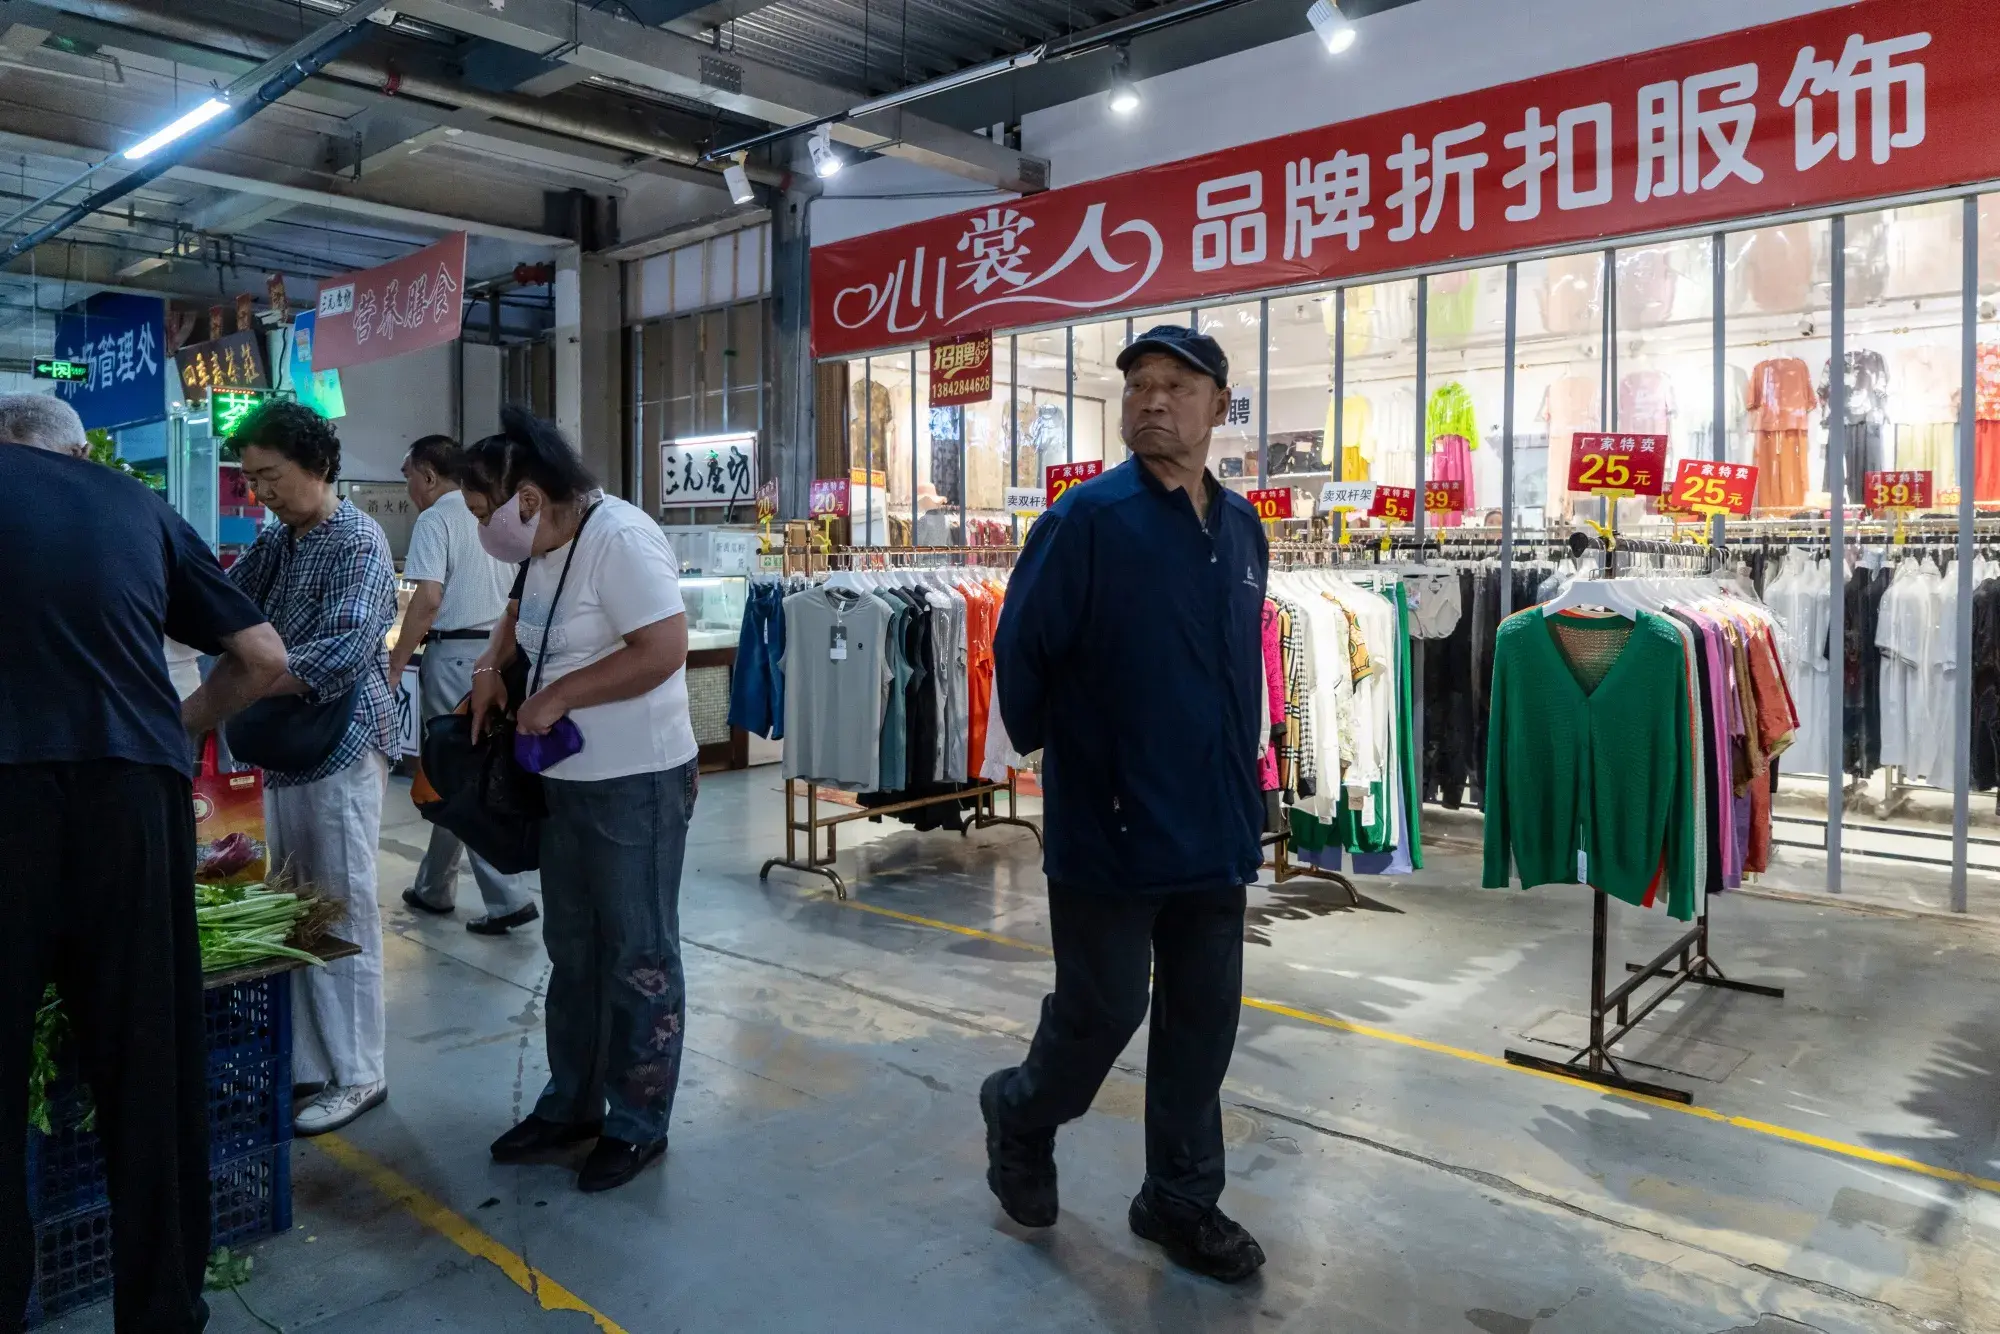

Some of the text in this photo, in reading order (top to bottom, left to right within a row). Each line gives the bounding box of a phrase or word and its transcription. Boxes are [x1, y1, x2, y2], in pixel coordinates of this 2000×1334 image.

[1193, 31, 1932, 272] 品牌折扣服饰
[353, 262, 457, 345] 营养膳食
[934, 341, 975, 370] 招聘
[932, 375, 990, 399] 13842844628
[1223, 396, 1251, 425] 聘
[1580, 436, 1655, 453] 厂家特卖
[1051, 463, 1096, 479] 厂家特卖
[1578, 453, 1651, 486] 25元
[1684, 462, 1749, 480] 厂家特卖
[815, 481, 846, 492] 厂家特卖
[1250, 489, 1286, 500] 厂家特卖
[1323, 488, 1372, 502] 卖双杆架
[1681, 476, 1744, 506] 25元
[1872, 484, 1923, 505] 39元
[368, 499, 409, 513] 消火栓
[814, 492, 844, 513] 20元
[1384, 497, 1408, 517] 5元
[1424, 490, 1460, 508] 39元
